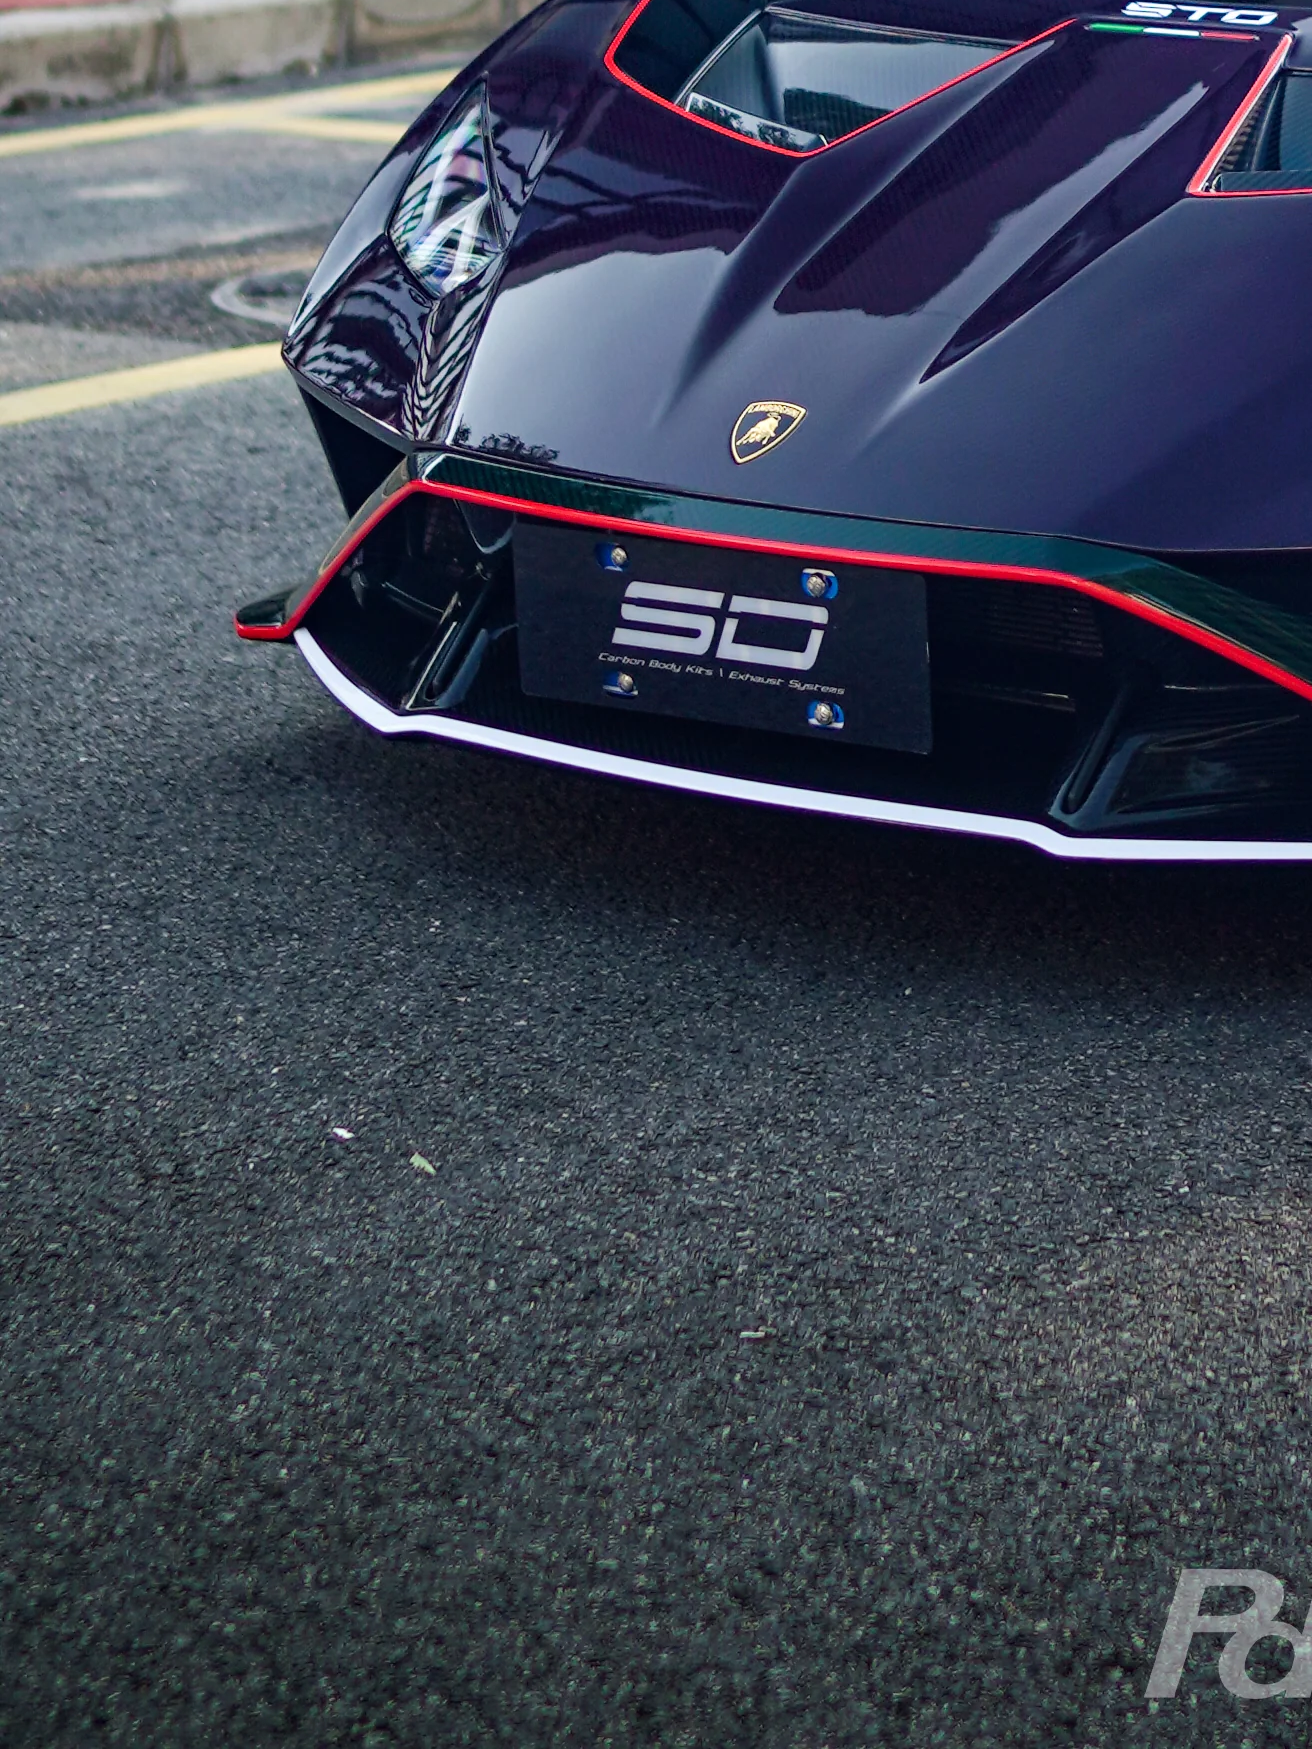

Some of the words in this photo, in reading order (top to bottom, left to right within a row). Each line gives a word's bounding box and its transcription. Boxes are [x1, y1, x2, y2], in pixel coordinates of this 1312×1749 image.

[1121, 1, 1278, 26] STO
[598, 652, 645, 667] Carbon
[648, 659, 682, 673] Body
[685, 664, 714, 676] Kits
[728, 670, 785, 687] Exhaust
[788, 679, 846, 696] Systems
